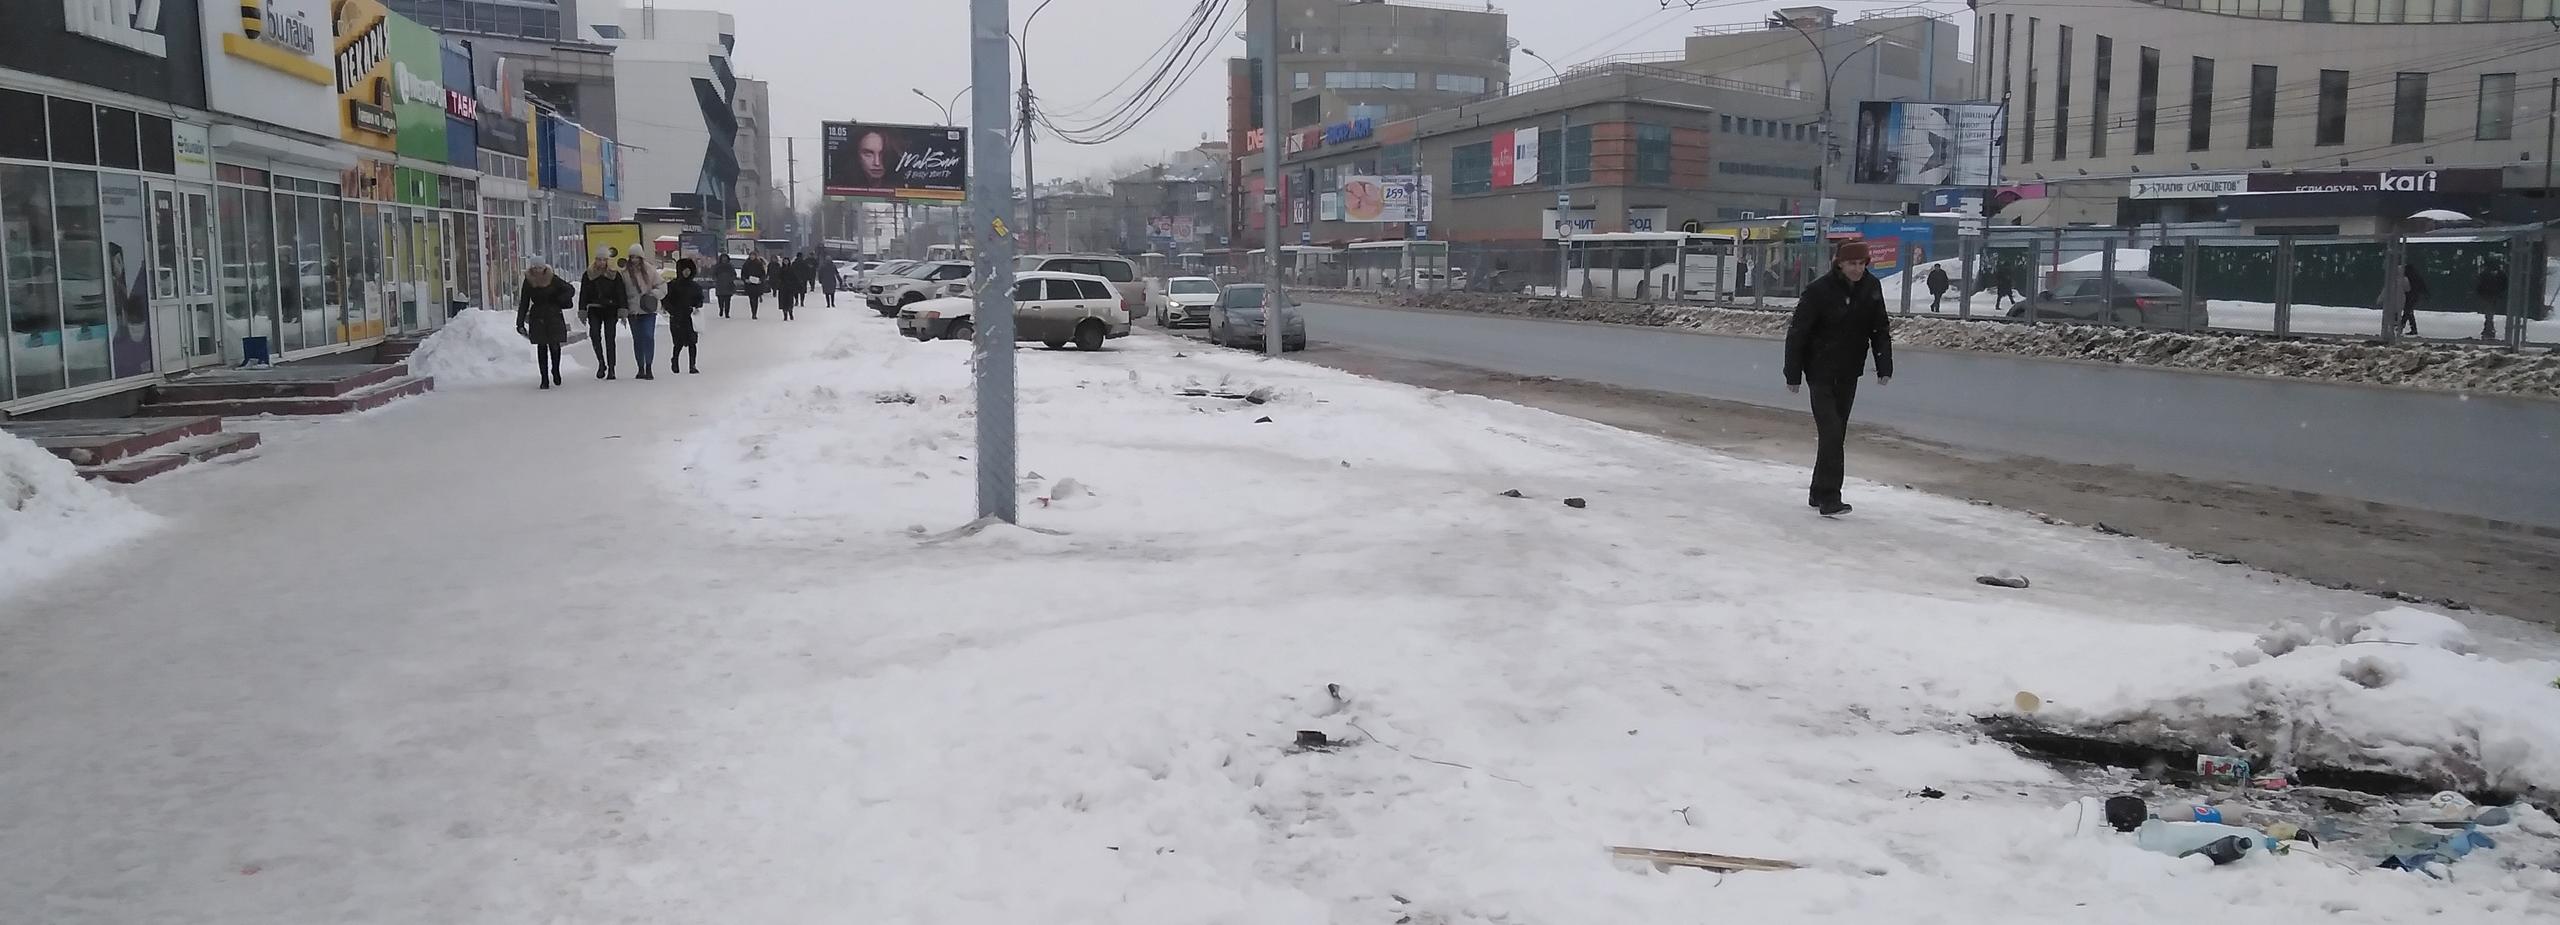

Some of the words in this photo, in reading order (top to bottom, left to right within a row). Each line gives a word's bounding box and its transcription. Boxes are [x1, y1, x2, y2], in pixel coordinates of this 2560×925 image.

[266, 0, 315, 54] билайн
[451, 91, 478, 121] ТАБАК
[828, 127, 847, 136] 18.05
[1247, 127, 1264, 152] DNS
[2380, 170, 2438, 192] kari
[1386, 187, 1404, 199] 259
